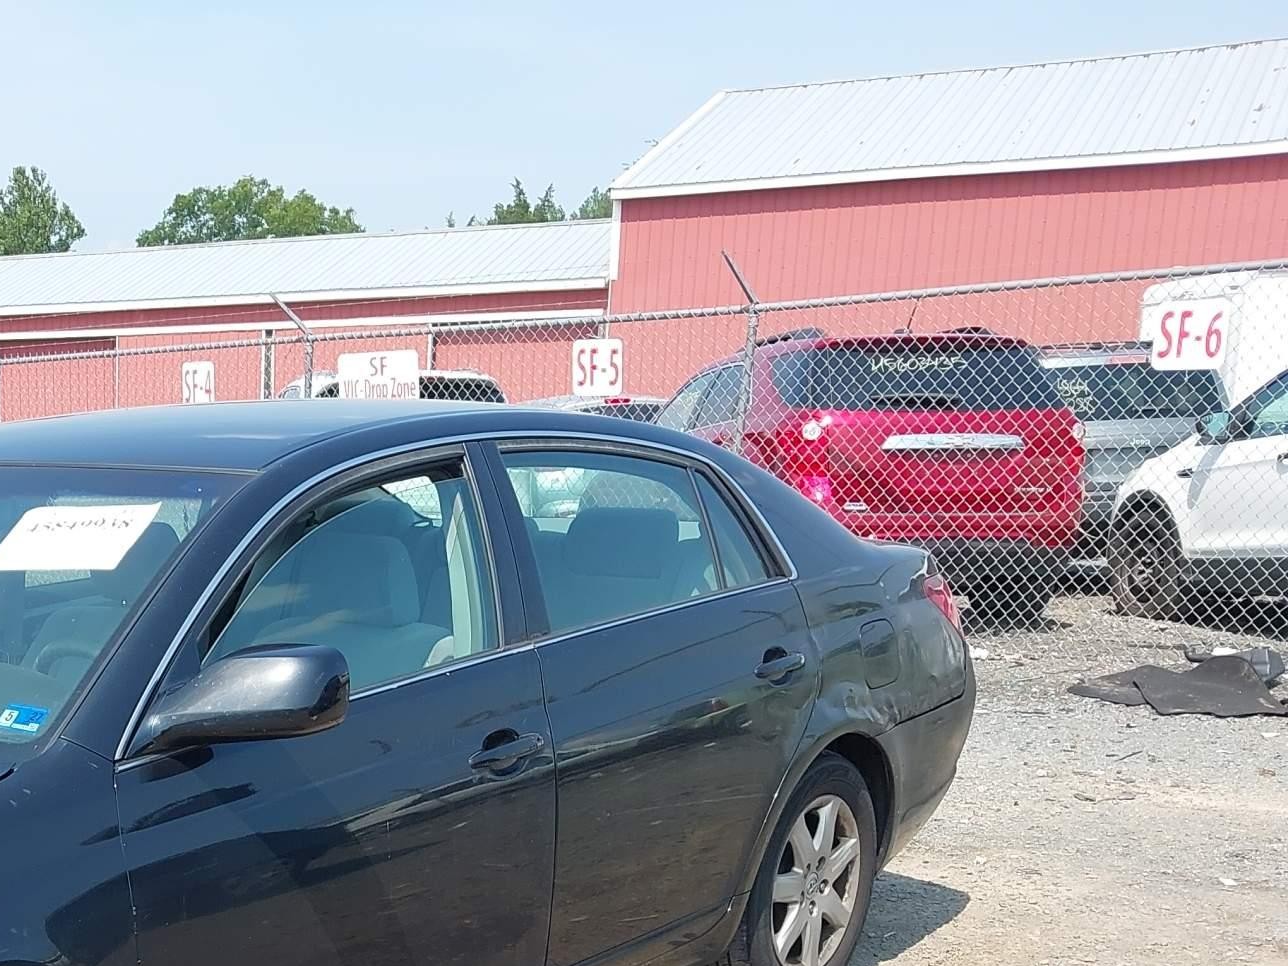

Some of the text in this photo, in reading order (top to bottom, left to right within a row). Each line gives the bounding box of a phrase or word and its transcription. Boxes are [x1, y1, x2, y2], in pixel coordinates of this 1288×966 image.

[1157, 310, 1223, 358] SF-6
[369, 356, 388, 376] SF
[577, 348, 619, 386] SF-5
[184, 369, 212, 403] SF-4
[391, 378, 416, 398] Zone
[4, 711, 15, 722] 5
